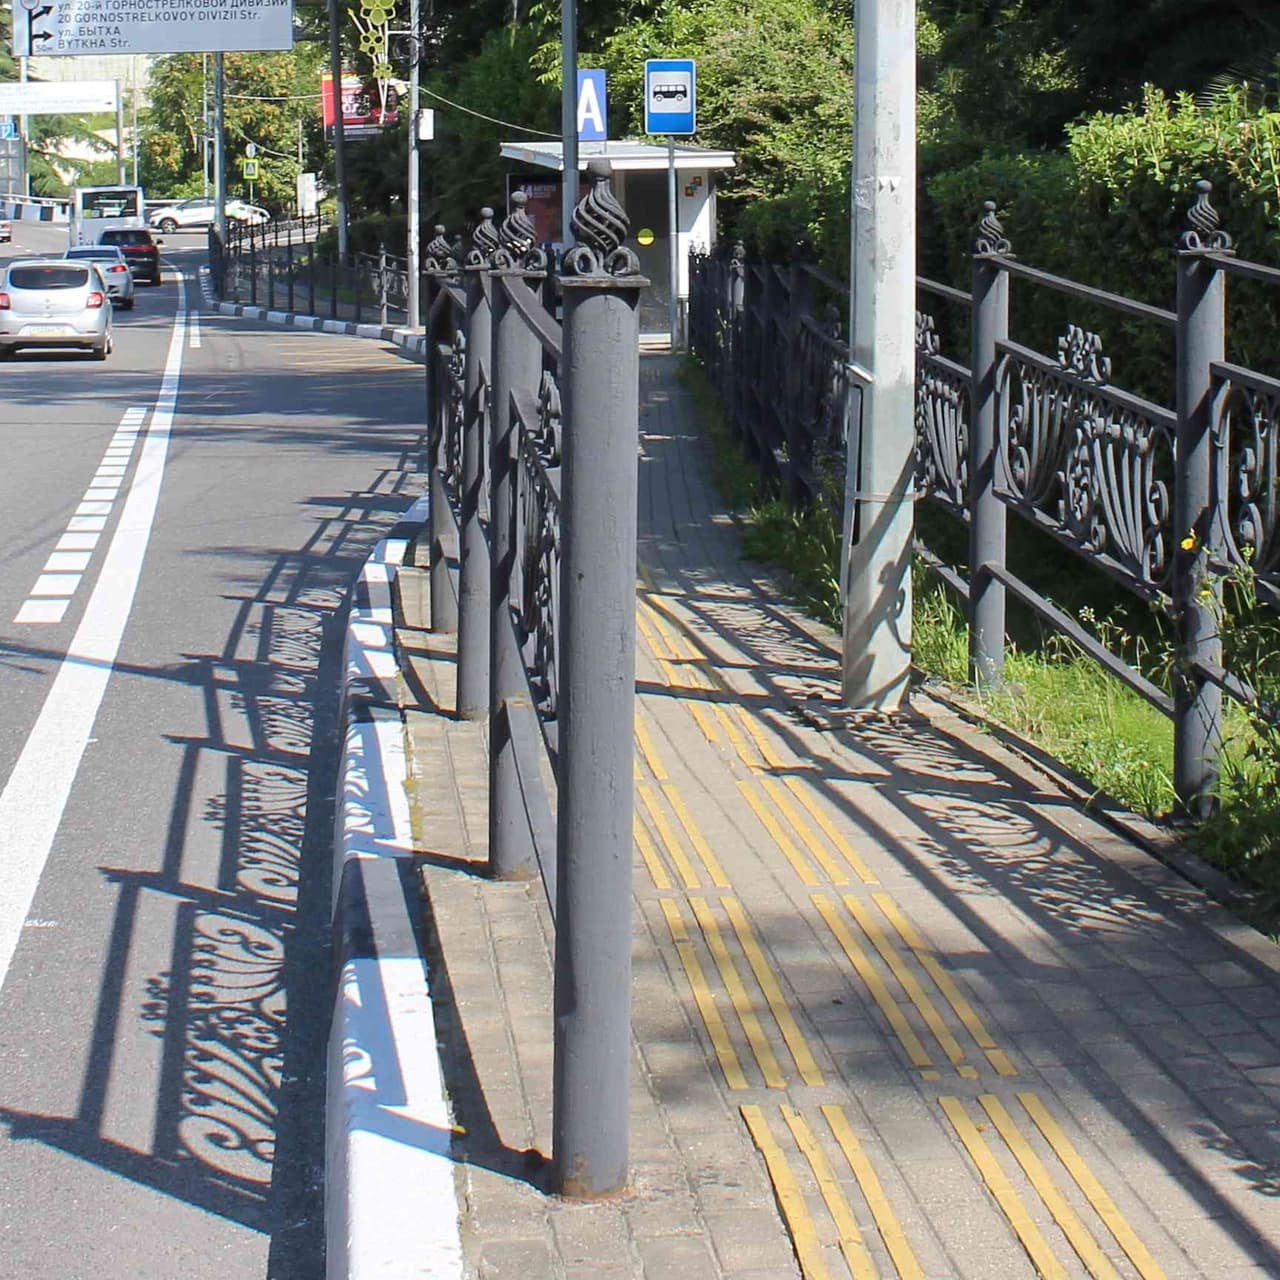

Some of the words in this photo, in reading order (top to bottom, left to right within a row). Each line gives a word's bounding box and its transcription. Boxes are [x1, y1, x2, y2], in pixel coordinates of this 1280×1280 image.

[58, 15, 71, 23] 20
[75, 11, 195, 23] GORNOSTRELKOVOY
[199, 10, 237, 21] DIVIZII
[240, 9, 261, 20] Str.
[79, 26, 120, 37] БЫТХА
[58, 39, 107, 49] BYTKHA
[110, 39, 131, 49] Str.
